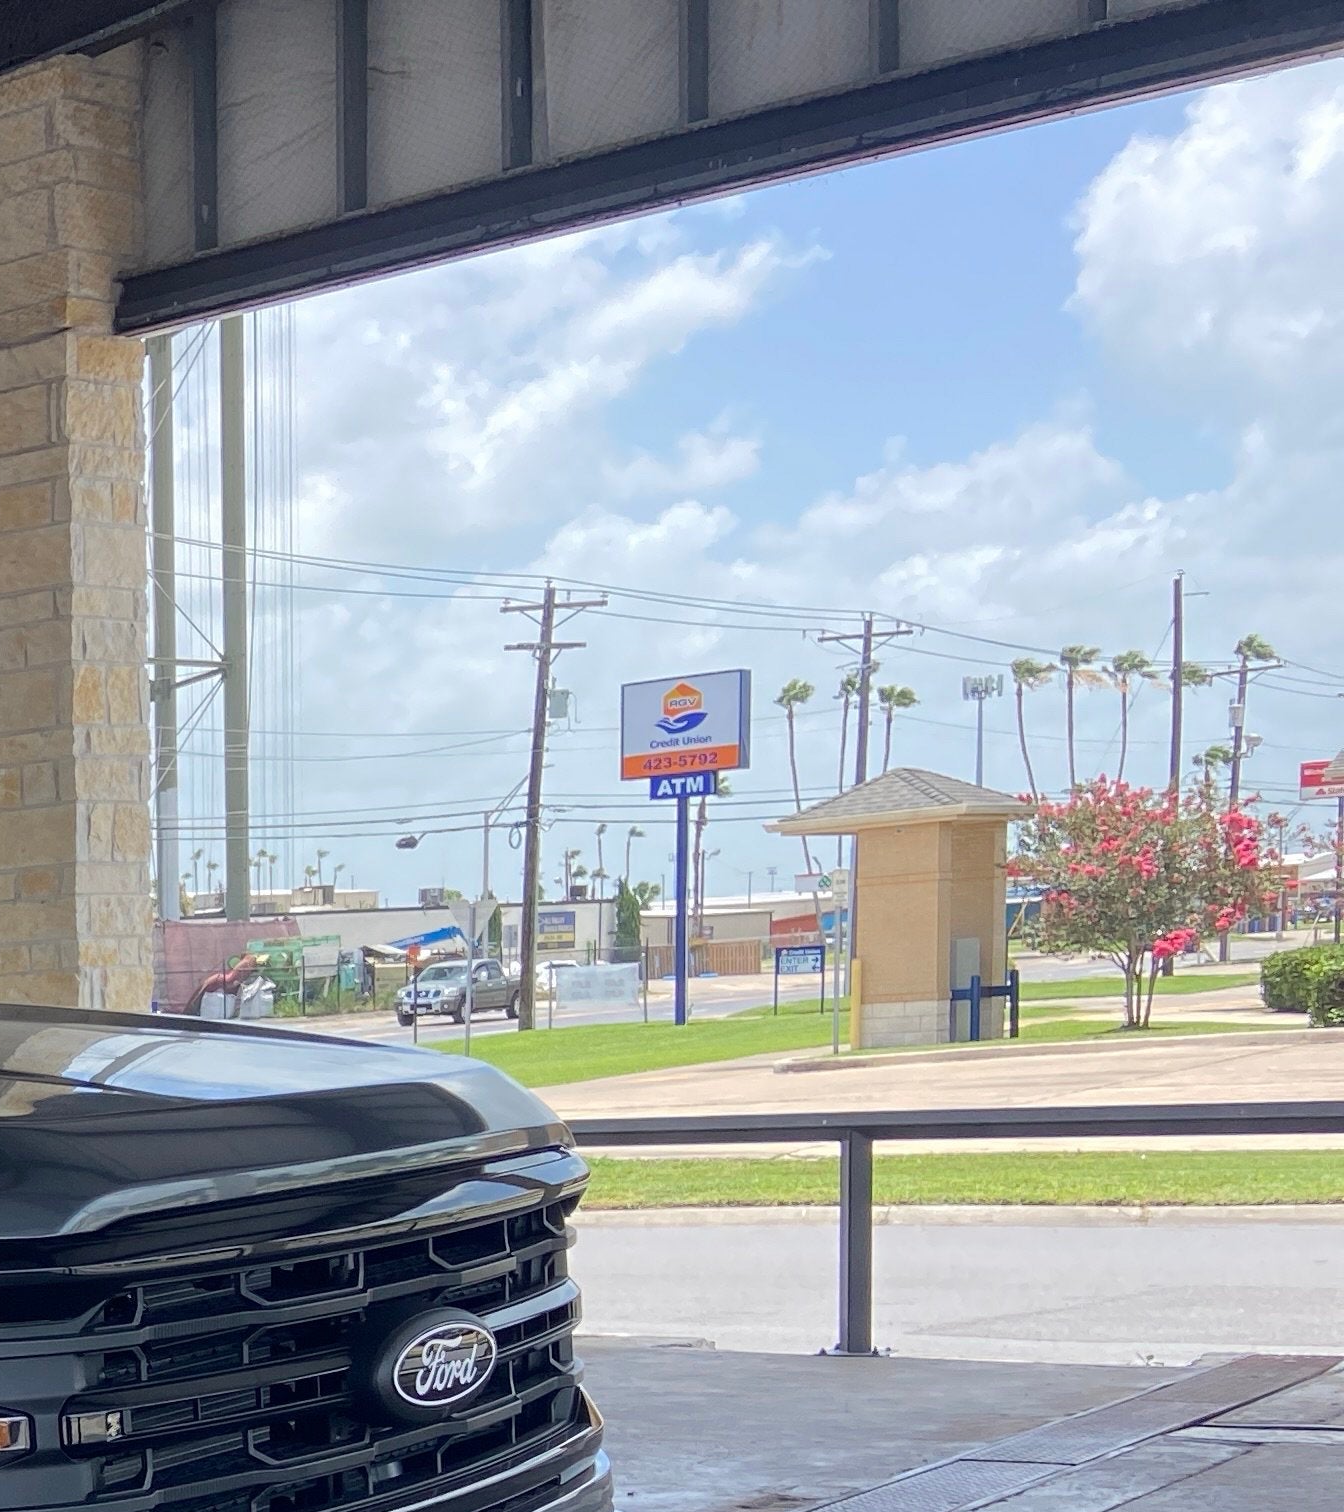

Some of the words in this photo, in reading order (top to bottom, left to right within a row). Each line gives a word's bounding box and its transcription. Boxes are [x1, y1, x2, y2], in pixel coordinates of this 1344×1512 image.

[649, 737, 680, 749] Credit
[682, 735, 712, 745] Union
[643, 751, 718, 771] 423-5792
[657, 775, 705, 797] ATM
[415, 1335, 478, 1396] Ford
